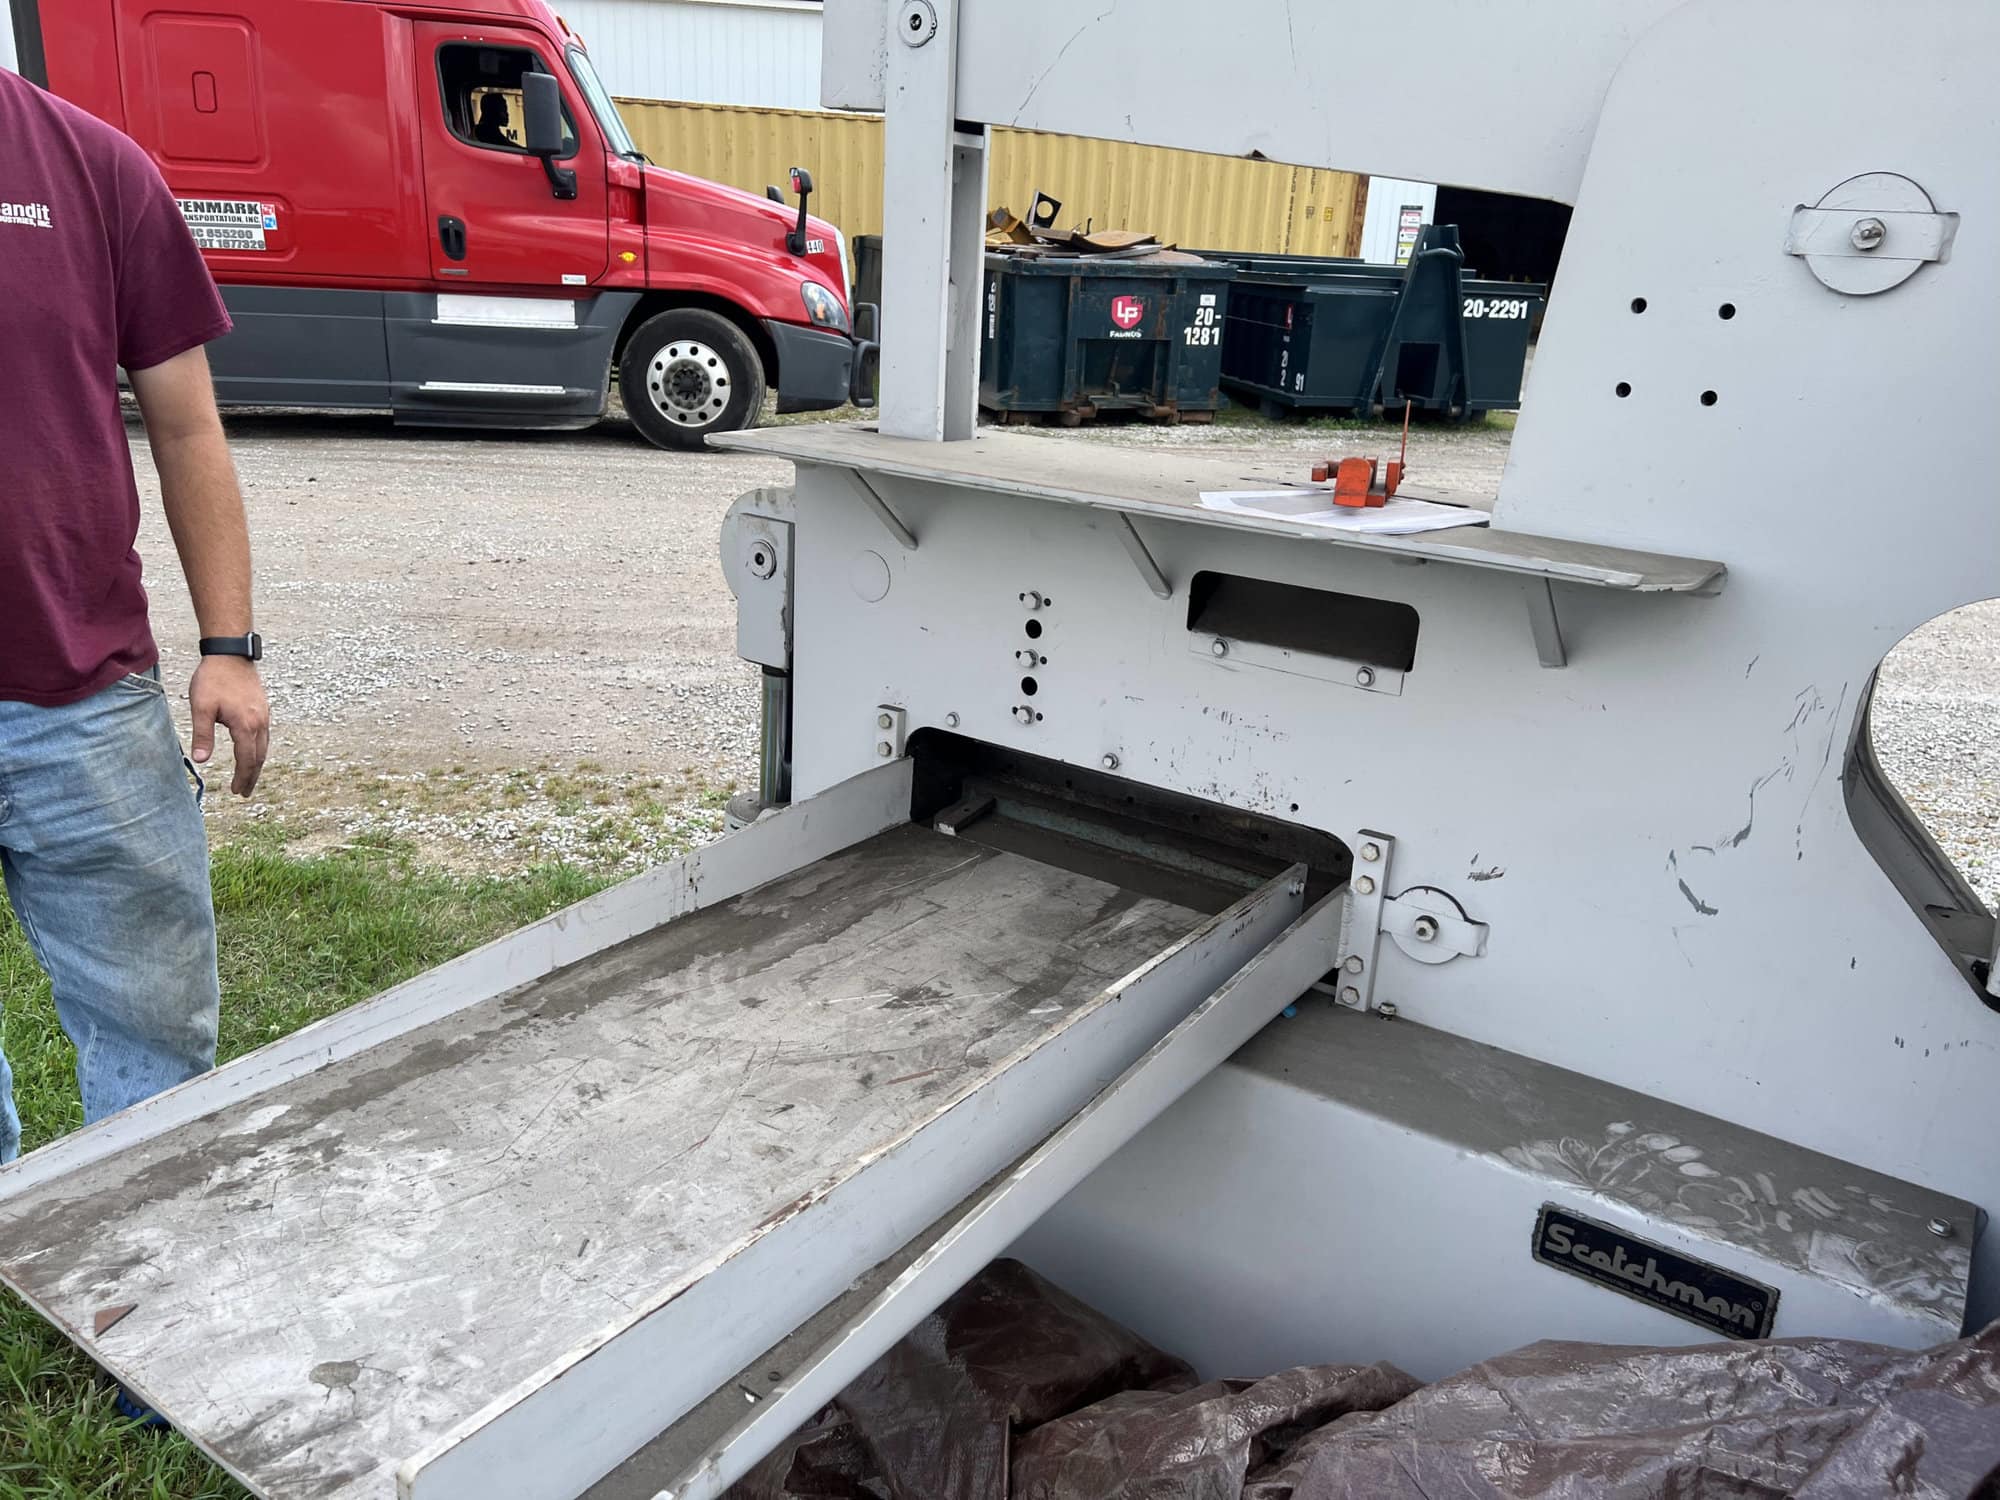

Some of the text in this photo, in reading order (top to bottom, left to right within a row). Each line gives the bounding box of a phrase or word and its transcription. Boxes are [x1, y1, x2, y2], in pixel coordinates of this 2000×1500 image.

[0, 202, 51, 221] andit
[1117, 300, 1138, 324] LP
[1194, 307, 1222, 326] 20-
[1463, 299, 1529, 319] 20-2291
[1184, 327, 1220, 346] 1281
[1545, 1223, 1757, 1331] Scotchman
